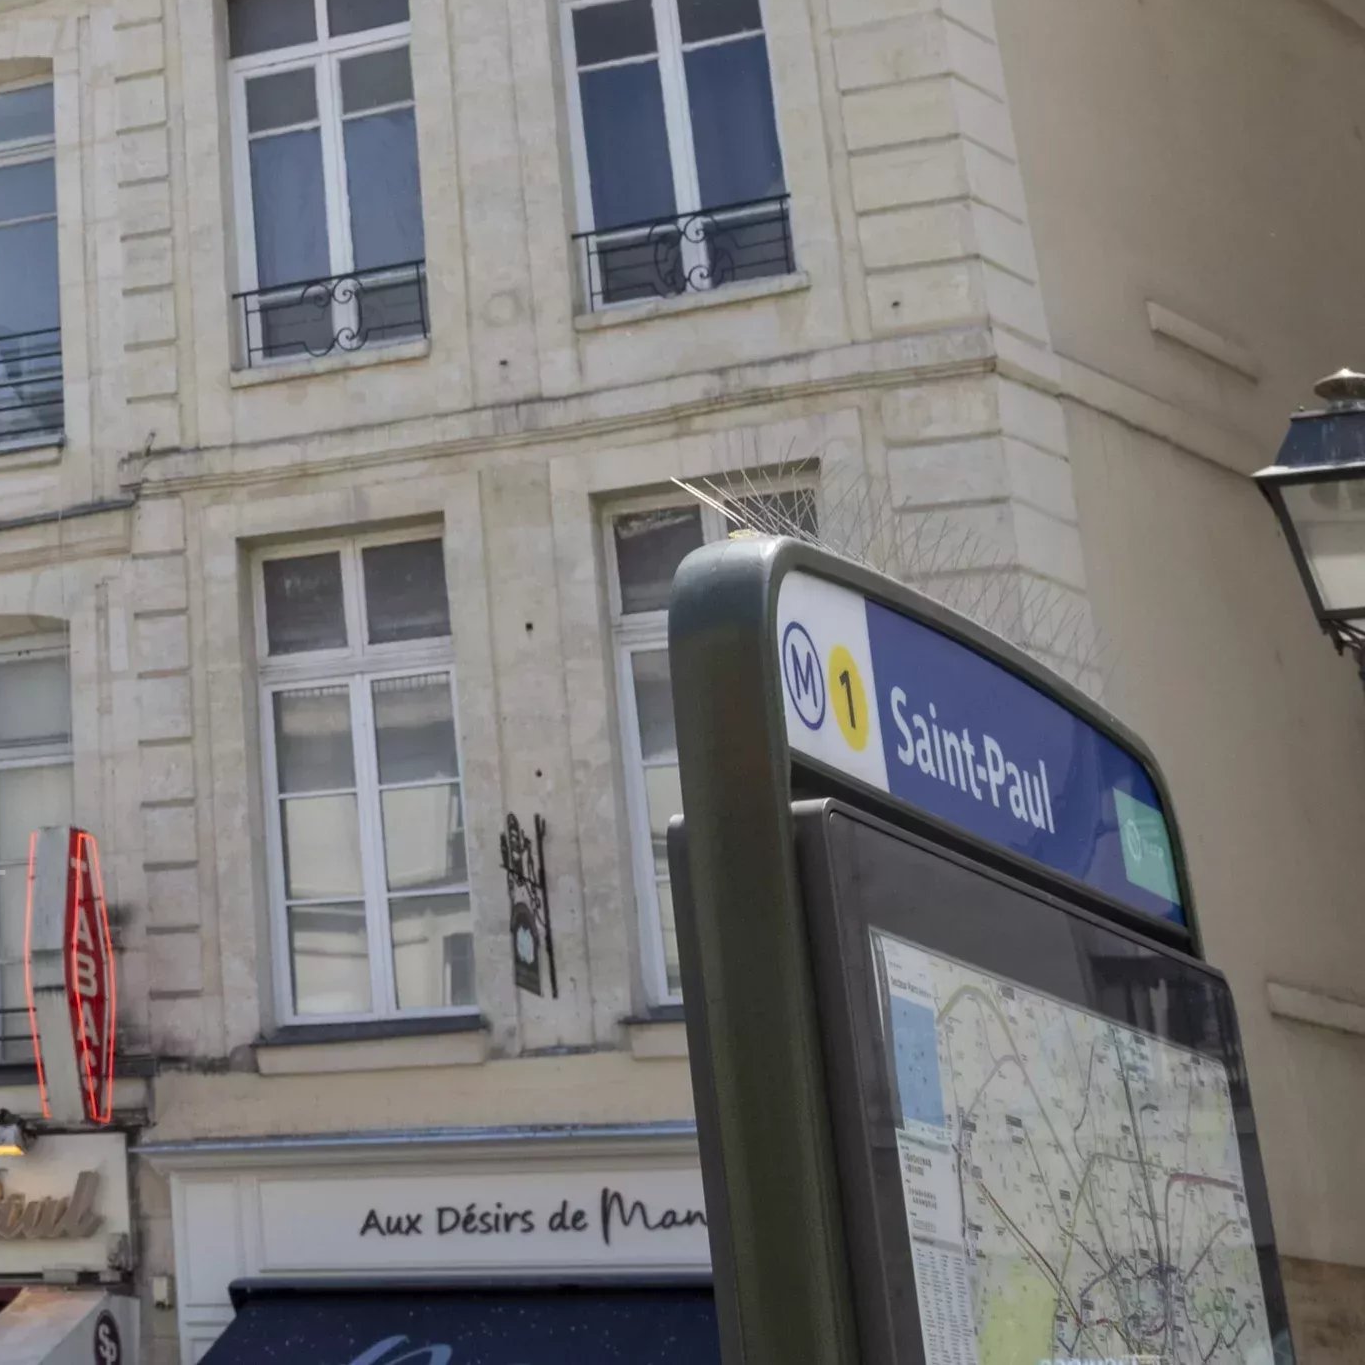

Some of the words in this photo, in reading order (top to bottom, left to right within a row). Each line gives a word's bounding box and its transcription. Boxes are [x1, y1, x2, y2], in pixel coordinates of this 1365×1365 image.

[839, 670, 857, 730] 1
[890, 685, 1056, 835] Saint-Paul
[70, 856, 100, 1092] TABAC
[360, 1209, 422, 1236] Aux
[437, 1202, 535, 1234] Désirs
[549, 1200, 588, 1232] de
